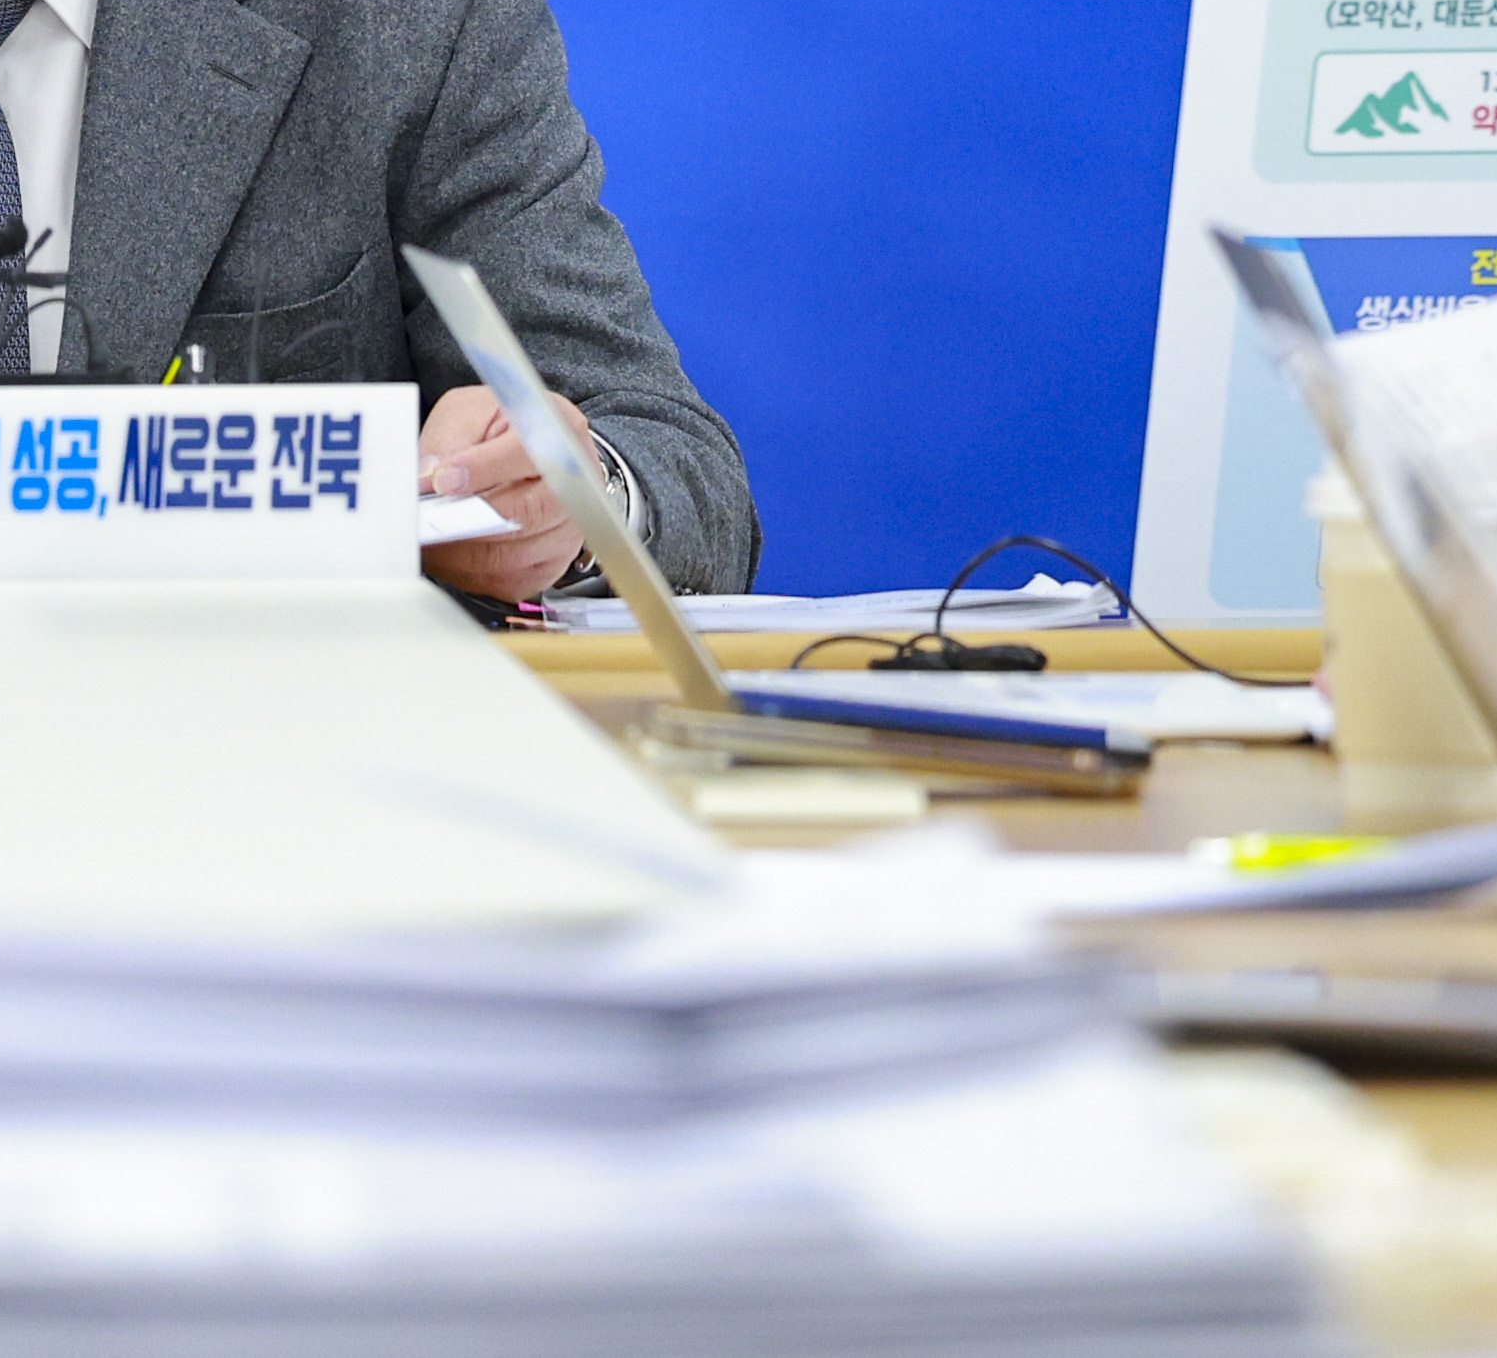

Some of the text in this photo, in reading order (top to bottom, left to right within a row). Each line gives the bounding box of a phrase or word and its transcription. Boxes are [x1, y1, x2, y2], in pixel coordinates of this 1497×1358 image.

[11, 418, 108, 521] 성공,
[118, 414, 256, 513] 새로운
[270, 413, 364, 513] 전북
